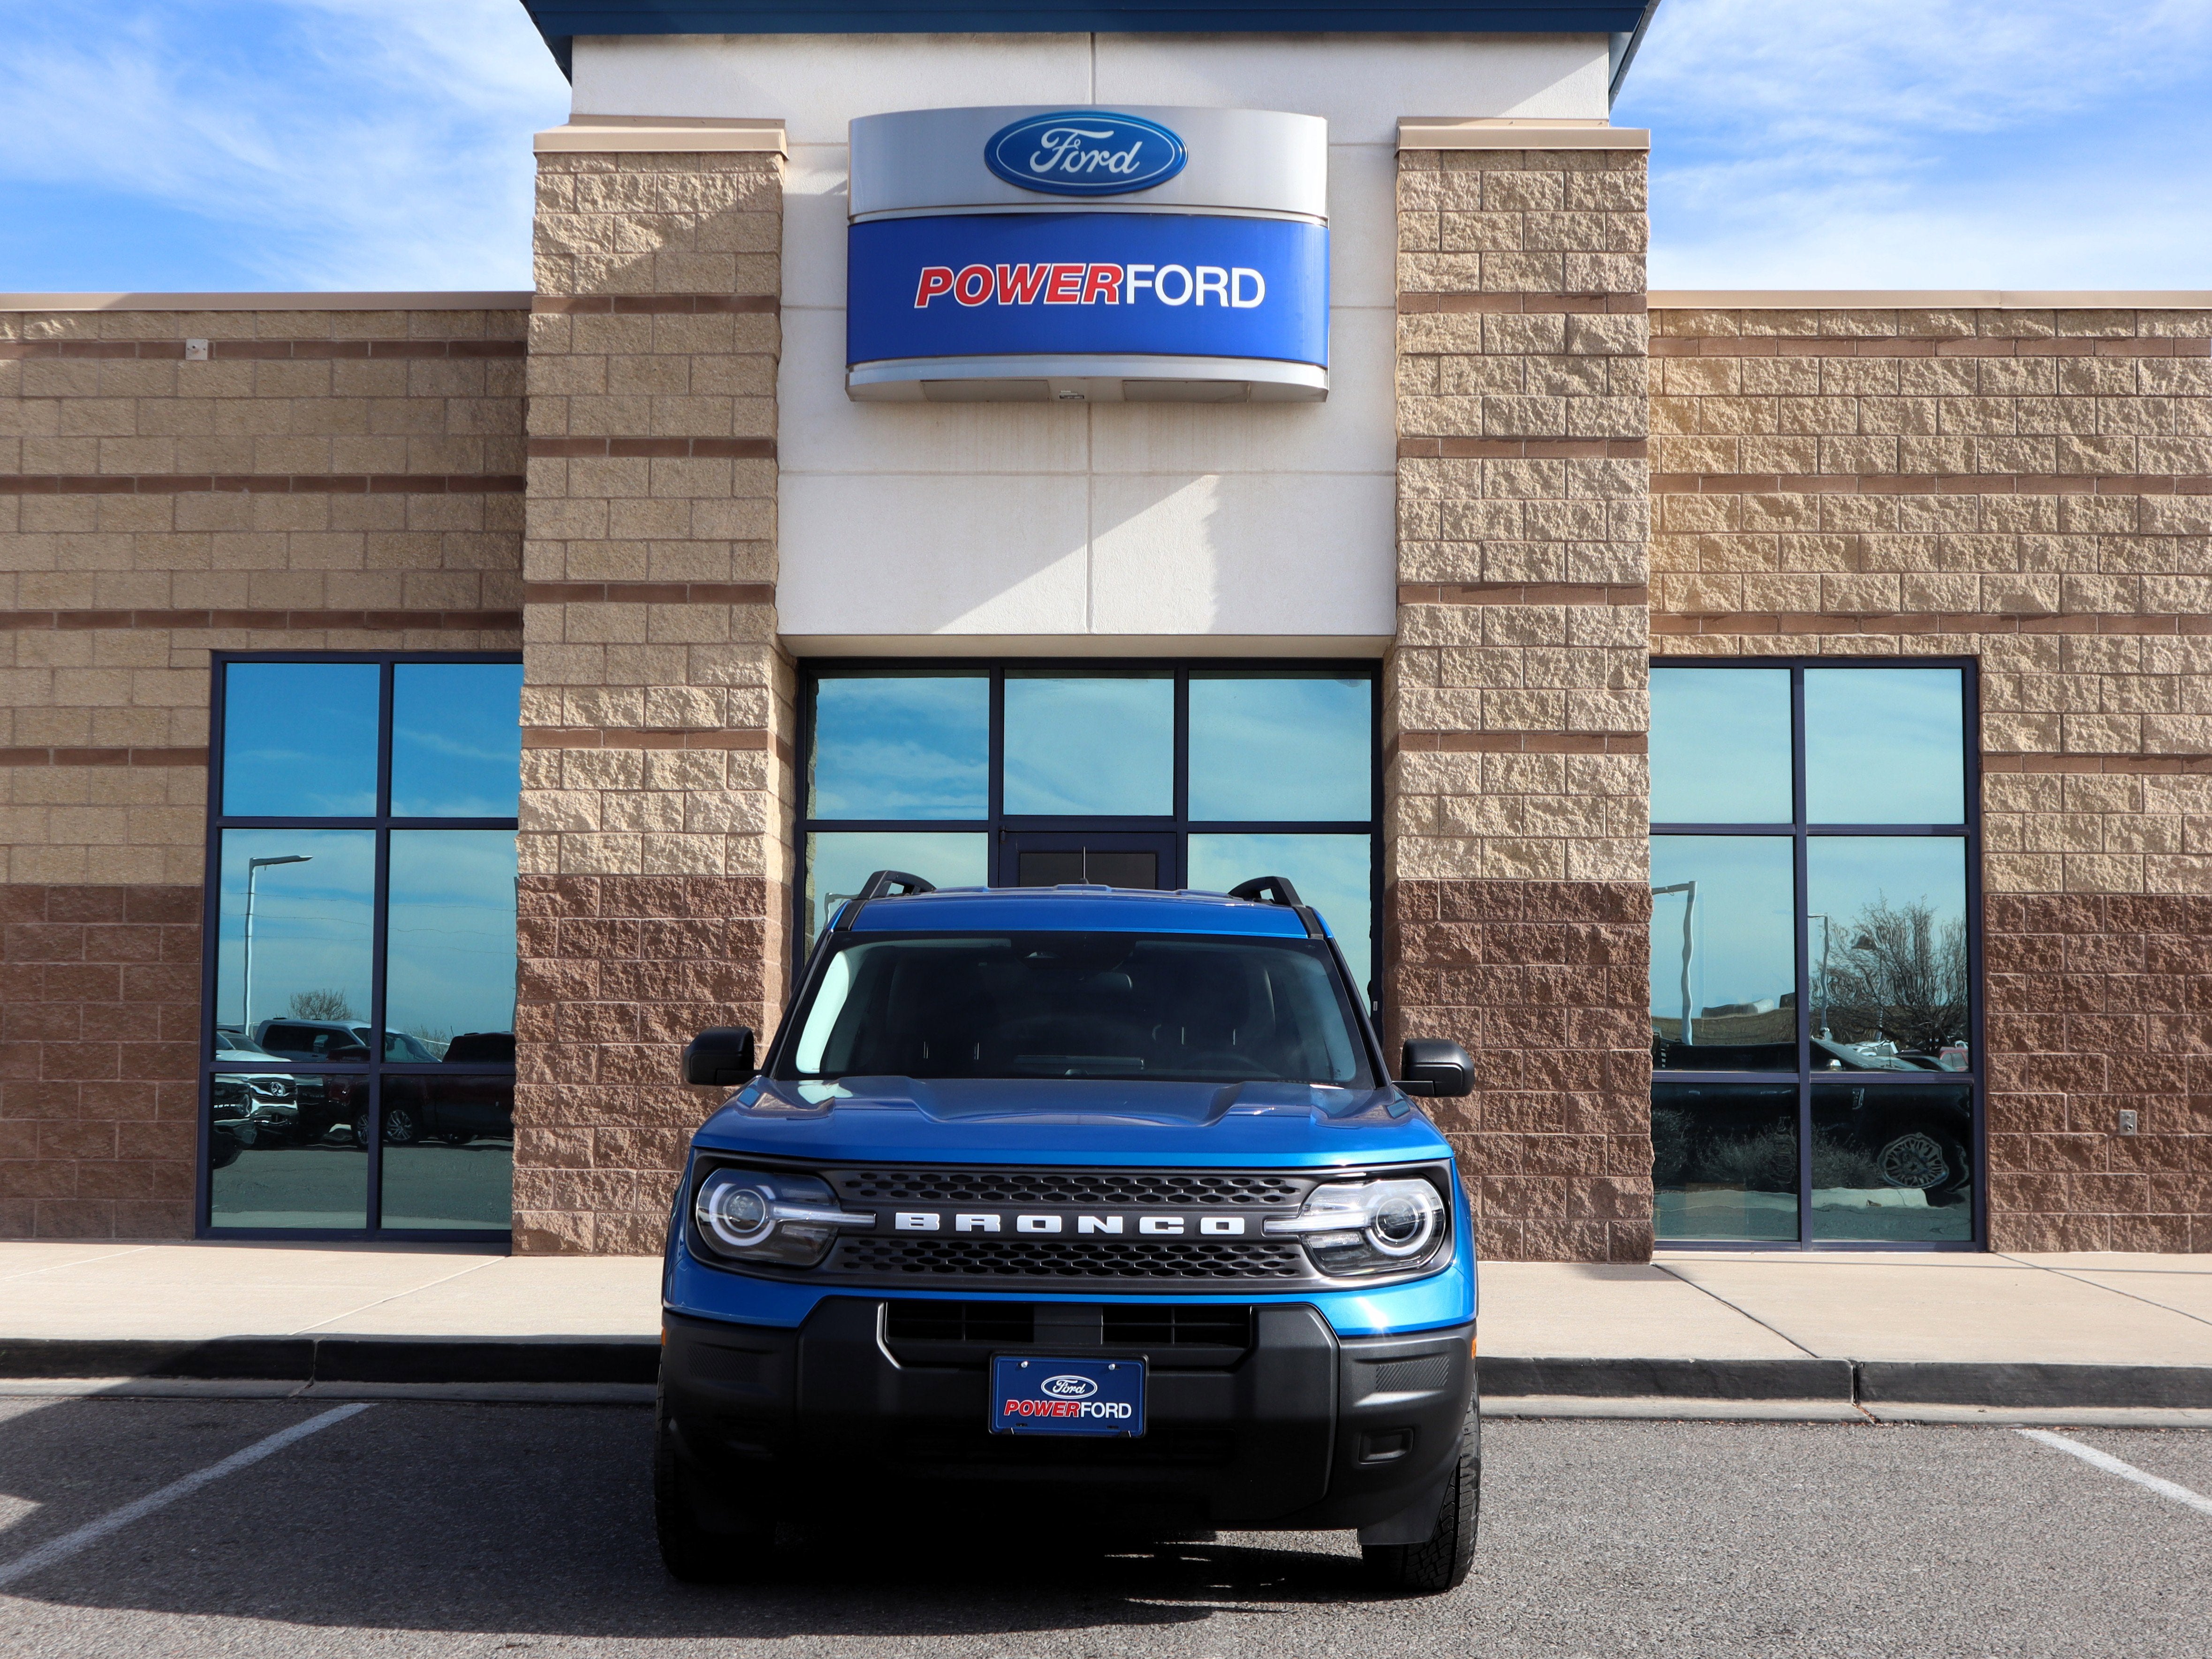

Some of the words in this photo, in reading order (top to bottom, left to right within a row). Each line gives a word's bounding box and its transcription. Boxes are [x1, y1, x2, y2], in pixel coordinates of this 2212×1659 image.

[1030, 128, 1143, 174] Ford
[895, 1212, 1245, 1235] BRONCO
[1052, 1379, 1086, 1394] Ford
